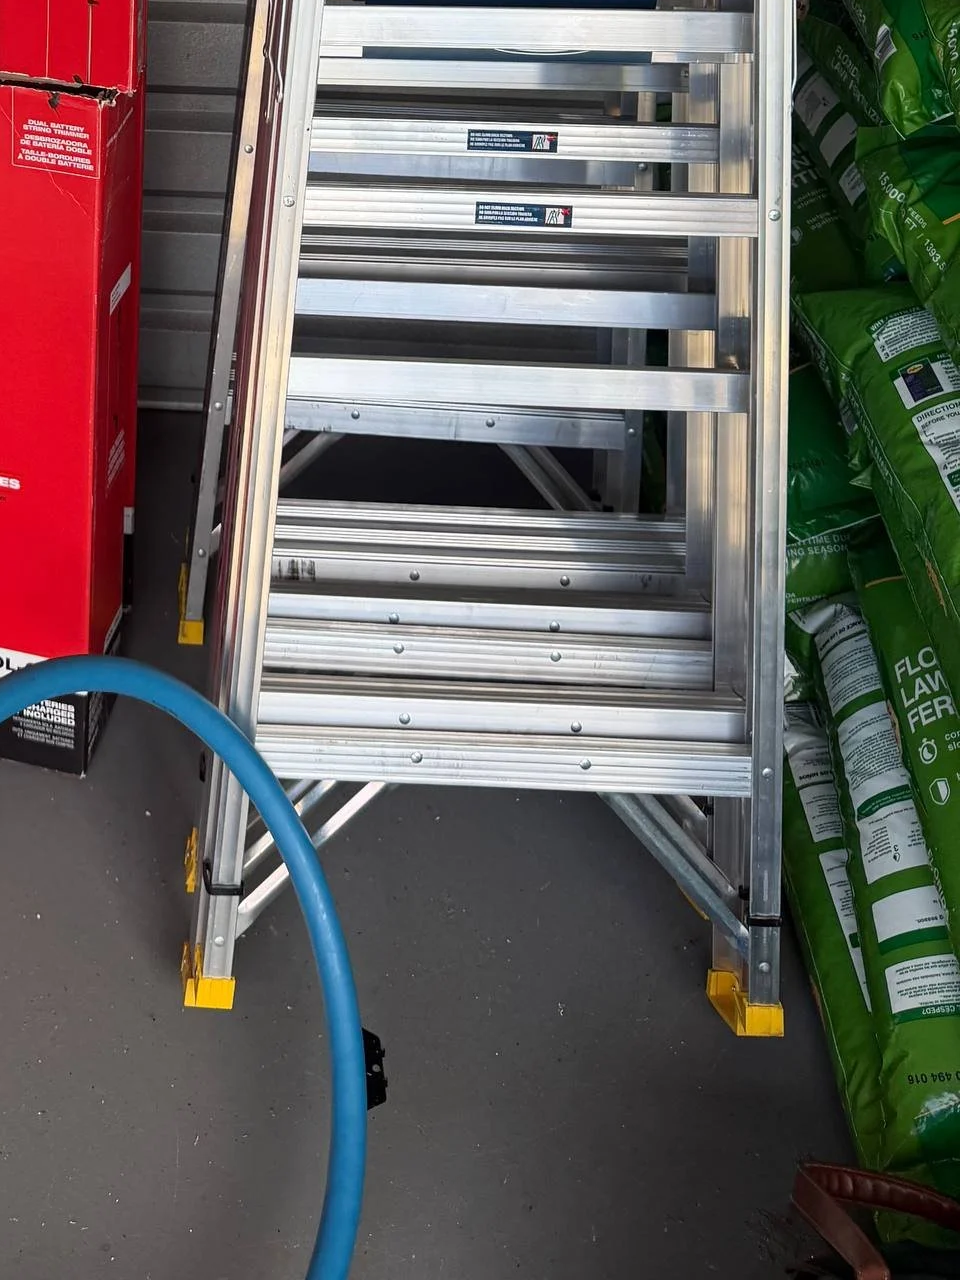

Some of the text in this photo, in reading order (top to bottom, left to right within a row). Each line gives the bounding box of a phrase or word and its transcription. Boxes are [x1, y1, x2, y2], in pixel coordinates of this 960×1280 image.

[23, 124, 90, 140] STRING TRIMMER
[28, 119, 84, 133] DUAL BATTERY
[20, 138, 31, 146] DE
[66, 146, 92, 156] DOBLE
[24, 134, 88, 150] DESBROZADORA
[21, 148, 92, 165] TAILLE-BORDURES
[24, 154, 94, 172] DOUBLE BATTERIE
[23, 708, 76, 727] INCLUDED
[907, 1071, 952, 1084] 494 016
